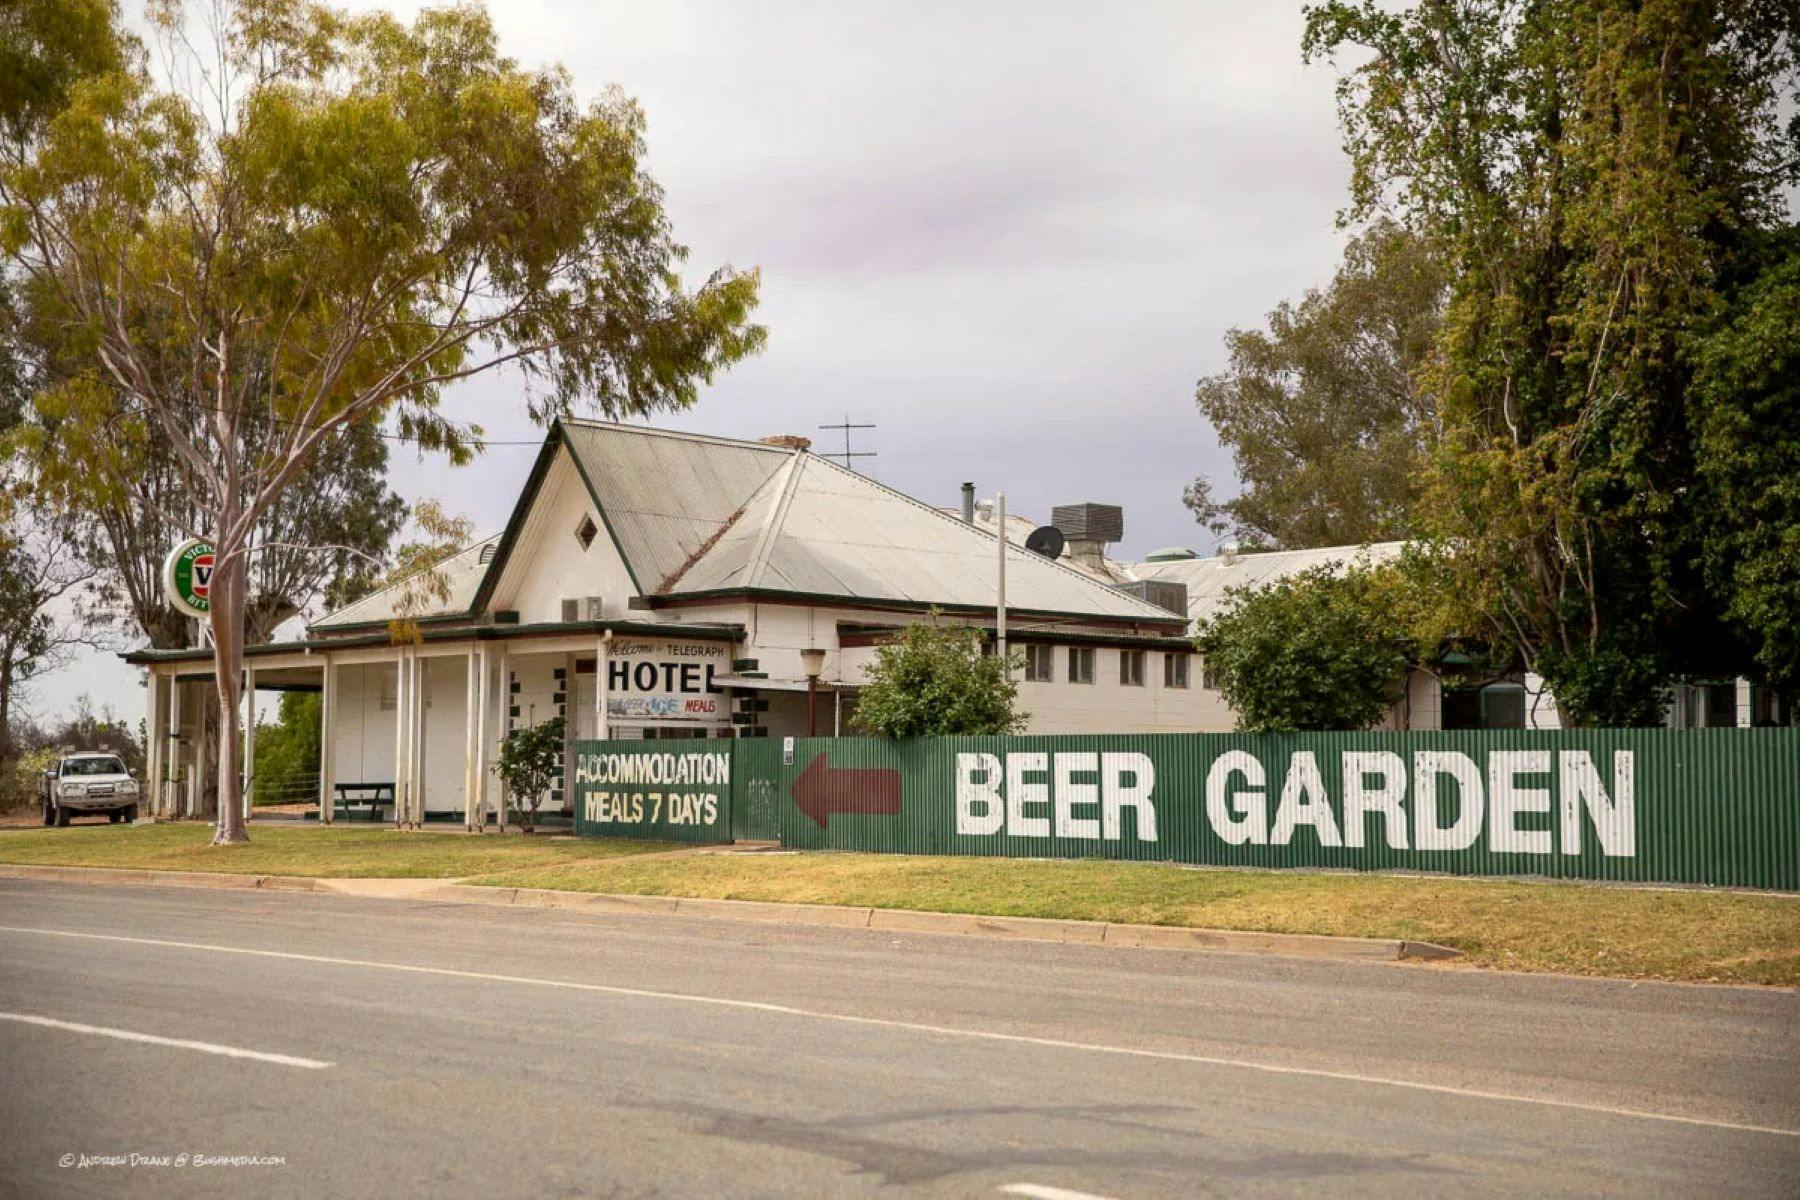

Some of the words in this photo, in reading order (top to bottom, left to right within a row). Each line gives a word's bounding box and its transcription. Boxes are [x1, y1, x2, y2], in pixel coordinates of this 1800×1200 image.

[667, 645, 724, 657] TELEGRAPH
[609, 661, 724, 693] HOTEL
[685, 699, 716, 713] MEALS
[576, 753, 730, 785] ACCOMMODATION
[585, 792, 643, 823] MEALS
[648, 793, 661, 824] 7
[669, 793, 718, 825] DAYS
[956, 752, 1158, 842] BEER
[1206, 750, 1635, 857] GARDEN
